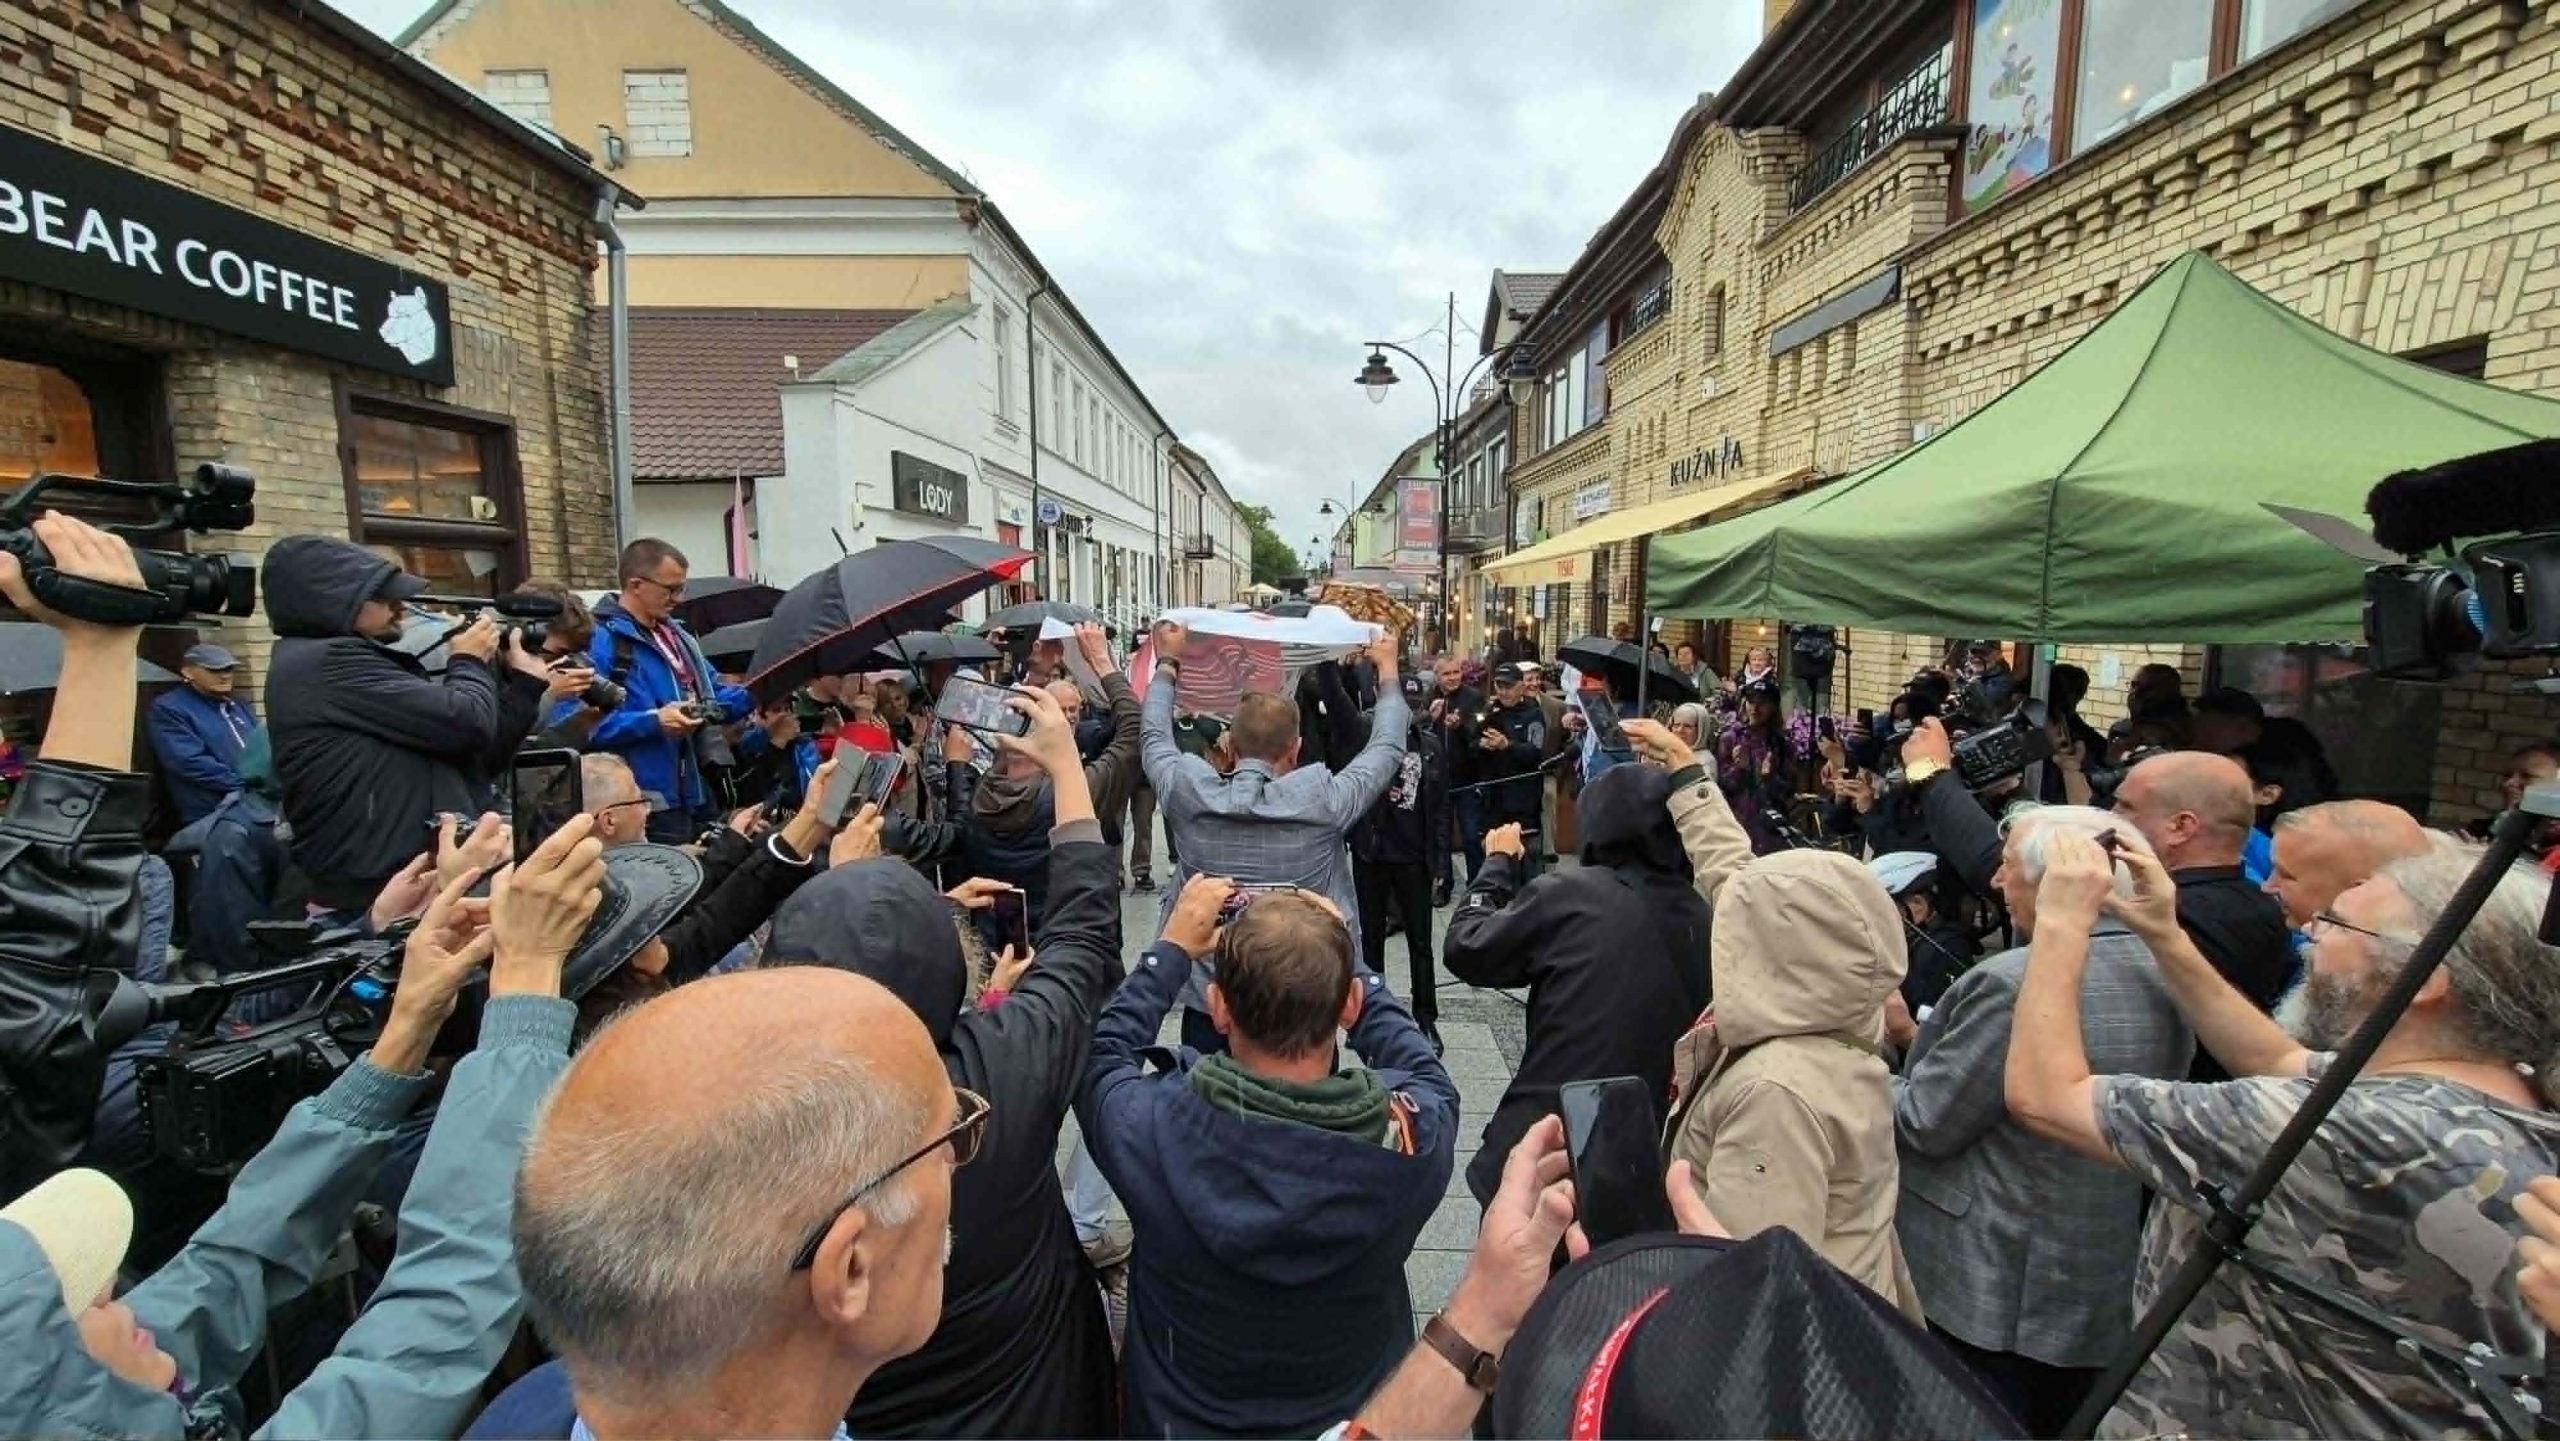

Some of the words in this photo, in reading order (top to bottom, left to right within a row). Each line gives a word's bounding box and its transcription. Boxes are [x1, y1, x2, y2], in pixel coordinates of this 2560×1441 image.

[0, 179, 164, 275] BEAR
[175, 238, 361, 331] COFFEE
[919, 480, 953, 516] LODY
